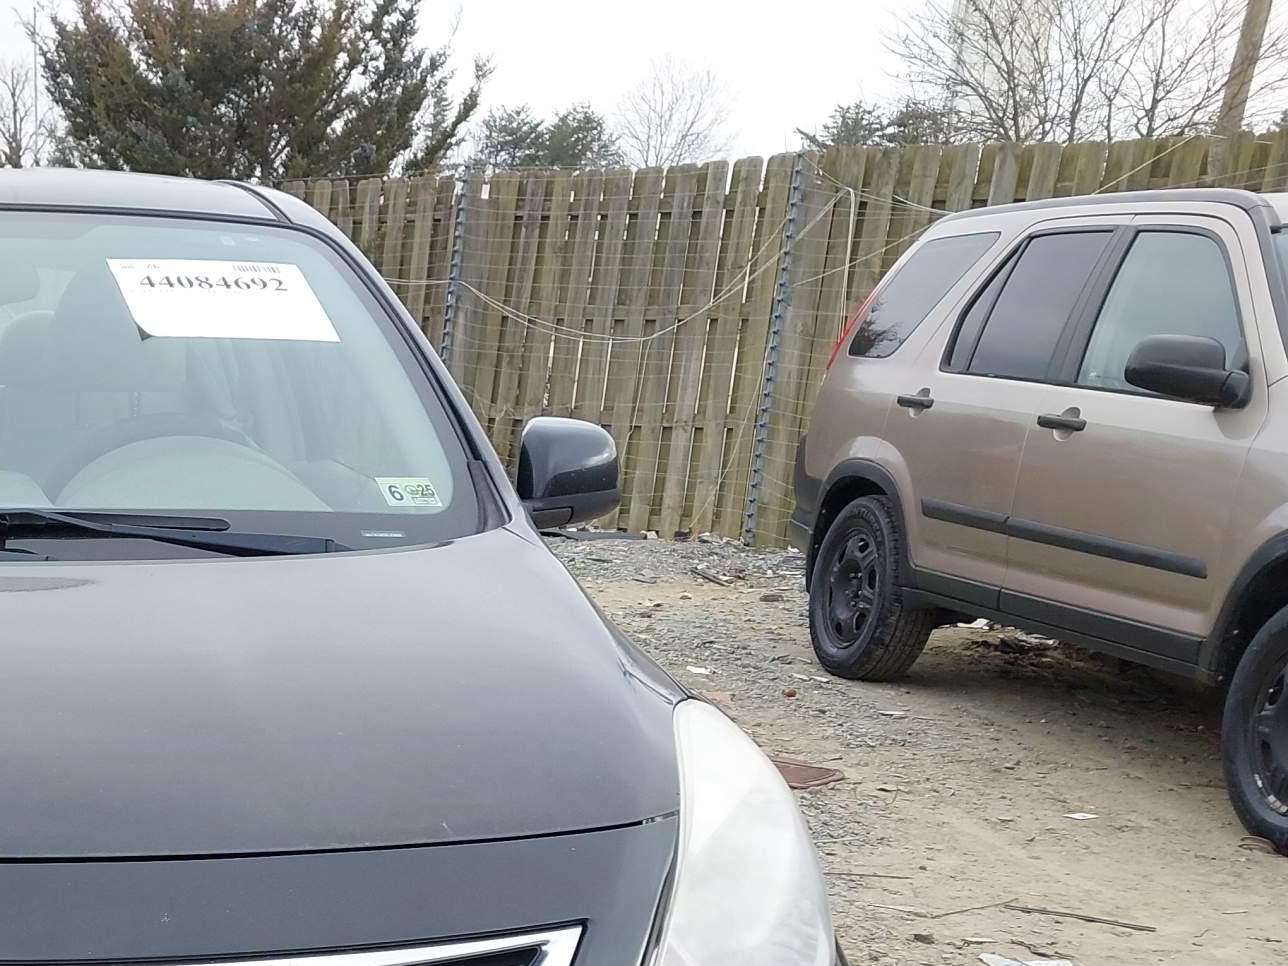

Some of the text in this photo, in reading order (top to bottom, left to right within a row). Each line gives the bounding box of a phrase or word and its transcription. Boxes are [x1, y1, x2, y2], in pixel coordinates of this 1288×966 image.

[139, 275, 288, 291] 44084692
[388, 485, 404, 501] 6
[417, 484, 435, 497] 25
